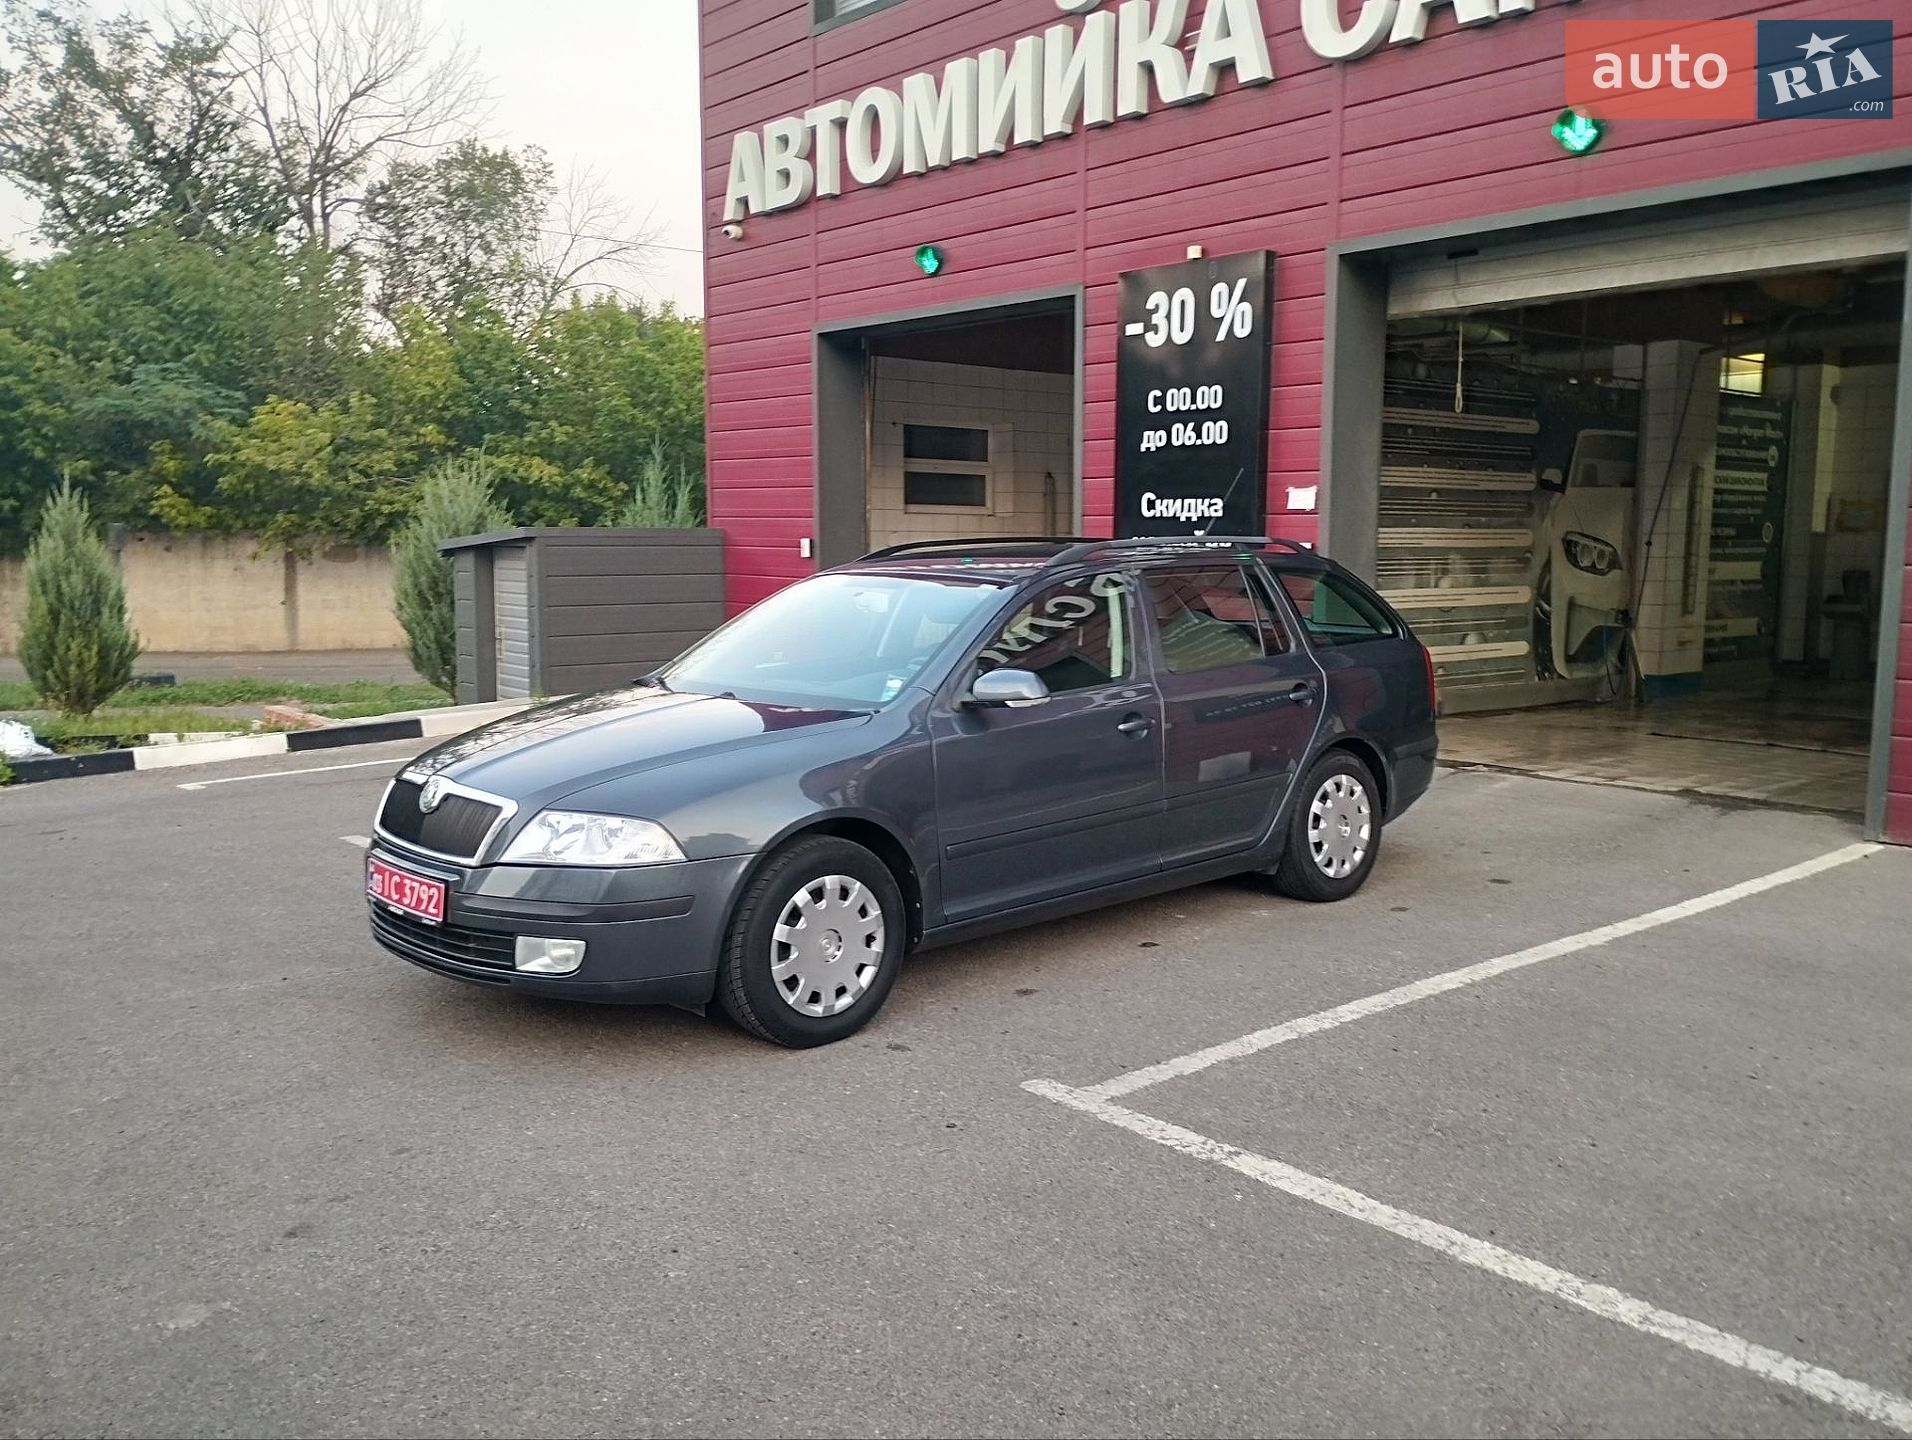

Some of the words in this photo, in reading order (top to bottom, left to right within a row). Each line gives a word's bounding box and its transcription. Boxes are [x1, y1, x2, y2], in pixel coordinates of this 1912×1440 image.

[723, 0, 1276, 221] АВТОМИЙКА
[1124, 287, 1196, 348] -30
[1210, 277, 1253, 342] %
[1165, 384, 1223, 412] 00.00
[1140, 429, 1168, 452] до
[1171, 420, 1229, 446] 06.00
[1140, 492, 1224, 521] Скидка
[402, 879, 439, 914] 3792
